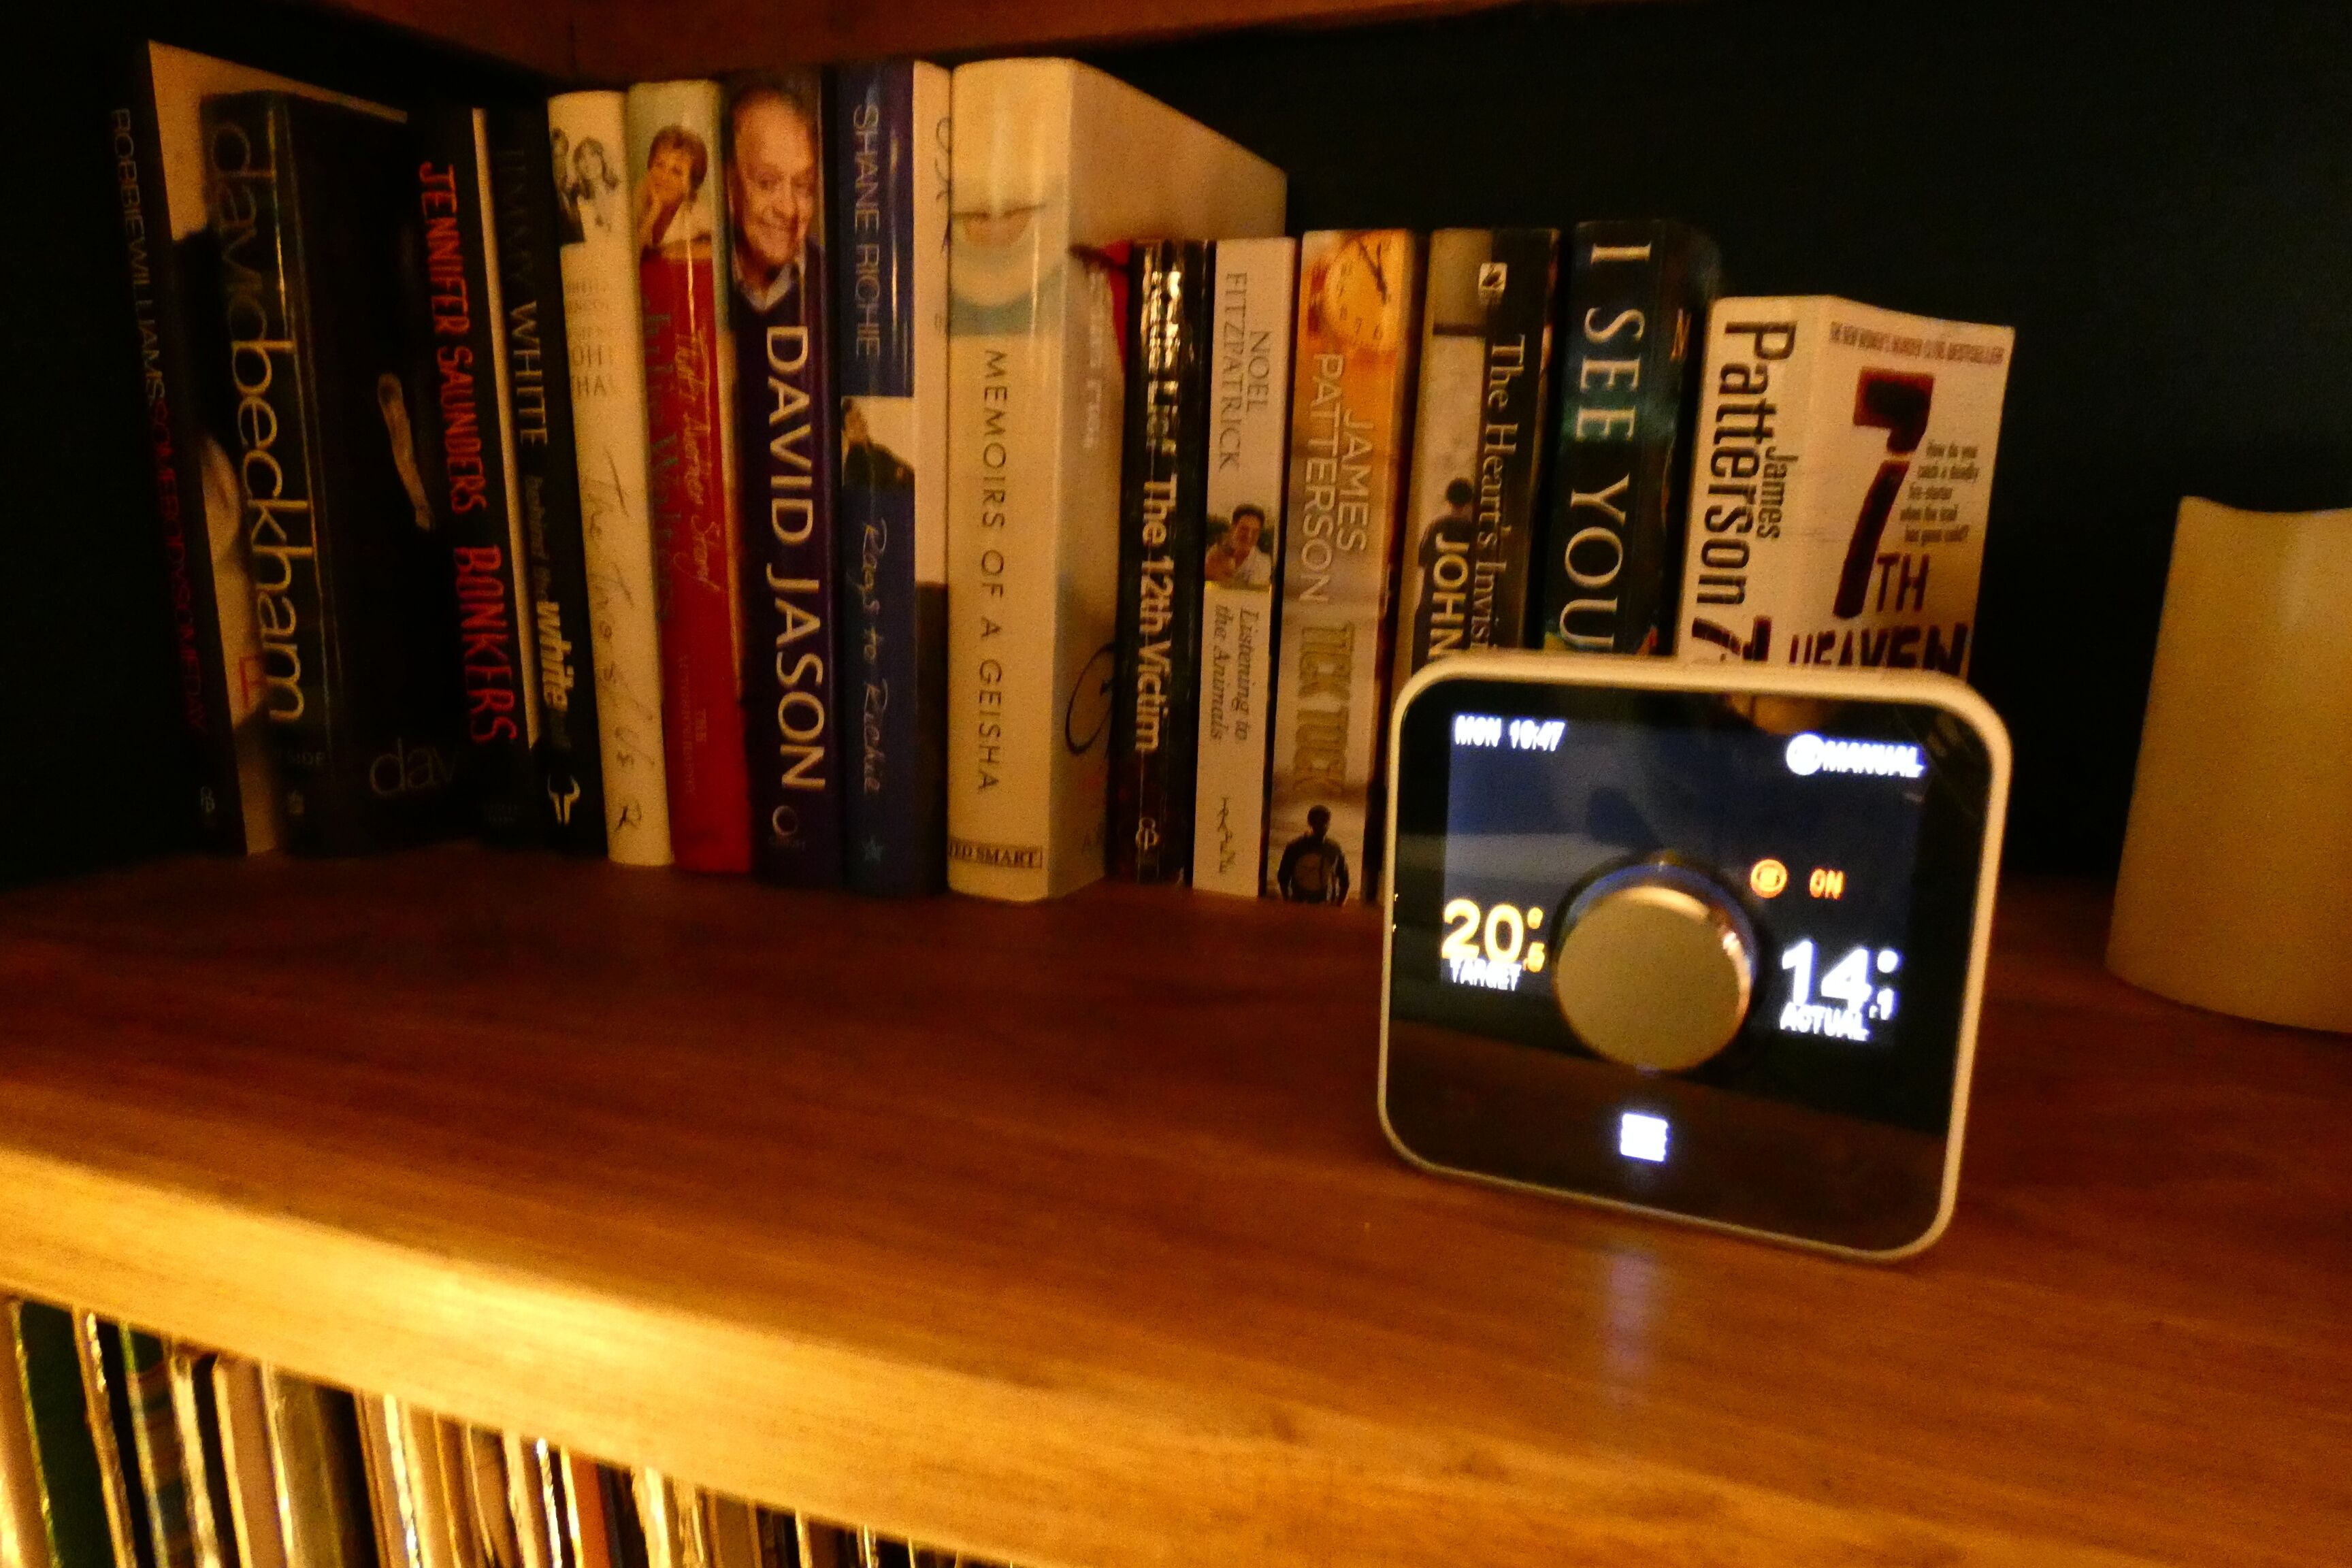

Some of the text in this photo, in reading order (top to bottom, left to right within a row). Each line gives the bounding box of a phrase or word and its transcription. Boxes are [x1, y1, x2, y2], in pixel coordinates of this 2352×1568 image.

[416, 161, 471, 336] JENNIFER
[853, 103, 881, 361] SHANE RICHIE
[434, 346, 488, 514] SAUNDERS
[508, 300, 548, 446] WHITE
[766, 325, 815, 546] DAVID
[1219, 272, 1247, 473] FITZPATRICK
[1247, 330, 1271, 414] NOEL
[1487, 334, 1525, 408] The
[1299, 353, 1344, 602] PATTERSON
[1335, 408, 1375, 551] JAMES
[1477, 422, 1519, 547] Heart's
[1560, 242, 1651, 652] I SEE YOU
[1696, 321, 1797, 606] Patterson
[1757, 446, 1799, 540] James
[231, 340, 316, 722] beckham
[847, 517, 888, 615] Rags
[976, 349, 1007, 791] MEMOIRS OF A GEISHA
[1428, 533, 1469, 657] JOHN
[453, 544, 519, 743] BONKERS
[536, 601, 575, 712] white
[766, 564, 827, 791] JASON
[862, 625, 885, 665] to
[1135, 472, 1178, 752] The 12th Victim
[1209, 604, 1234, 742] the Animals
[1231, 607, 1260, 742] Listening to
[1454, 715, 1502, 747] MON
[1822, 740, 1925, 778] MANUAL
[975, 845, 1038, 869] SMART
[1809, 868, 1845, 900] ON
[1449, 958, 1523, 992] TARGET
[1780, 1002, 1870, 1041] ACTUAL
